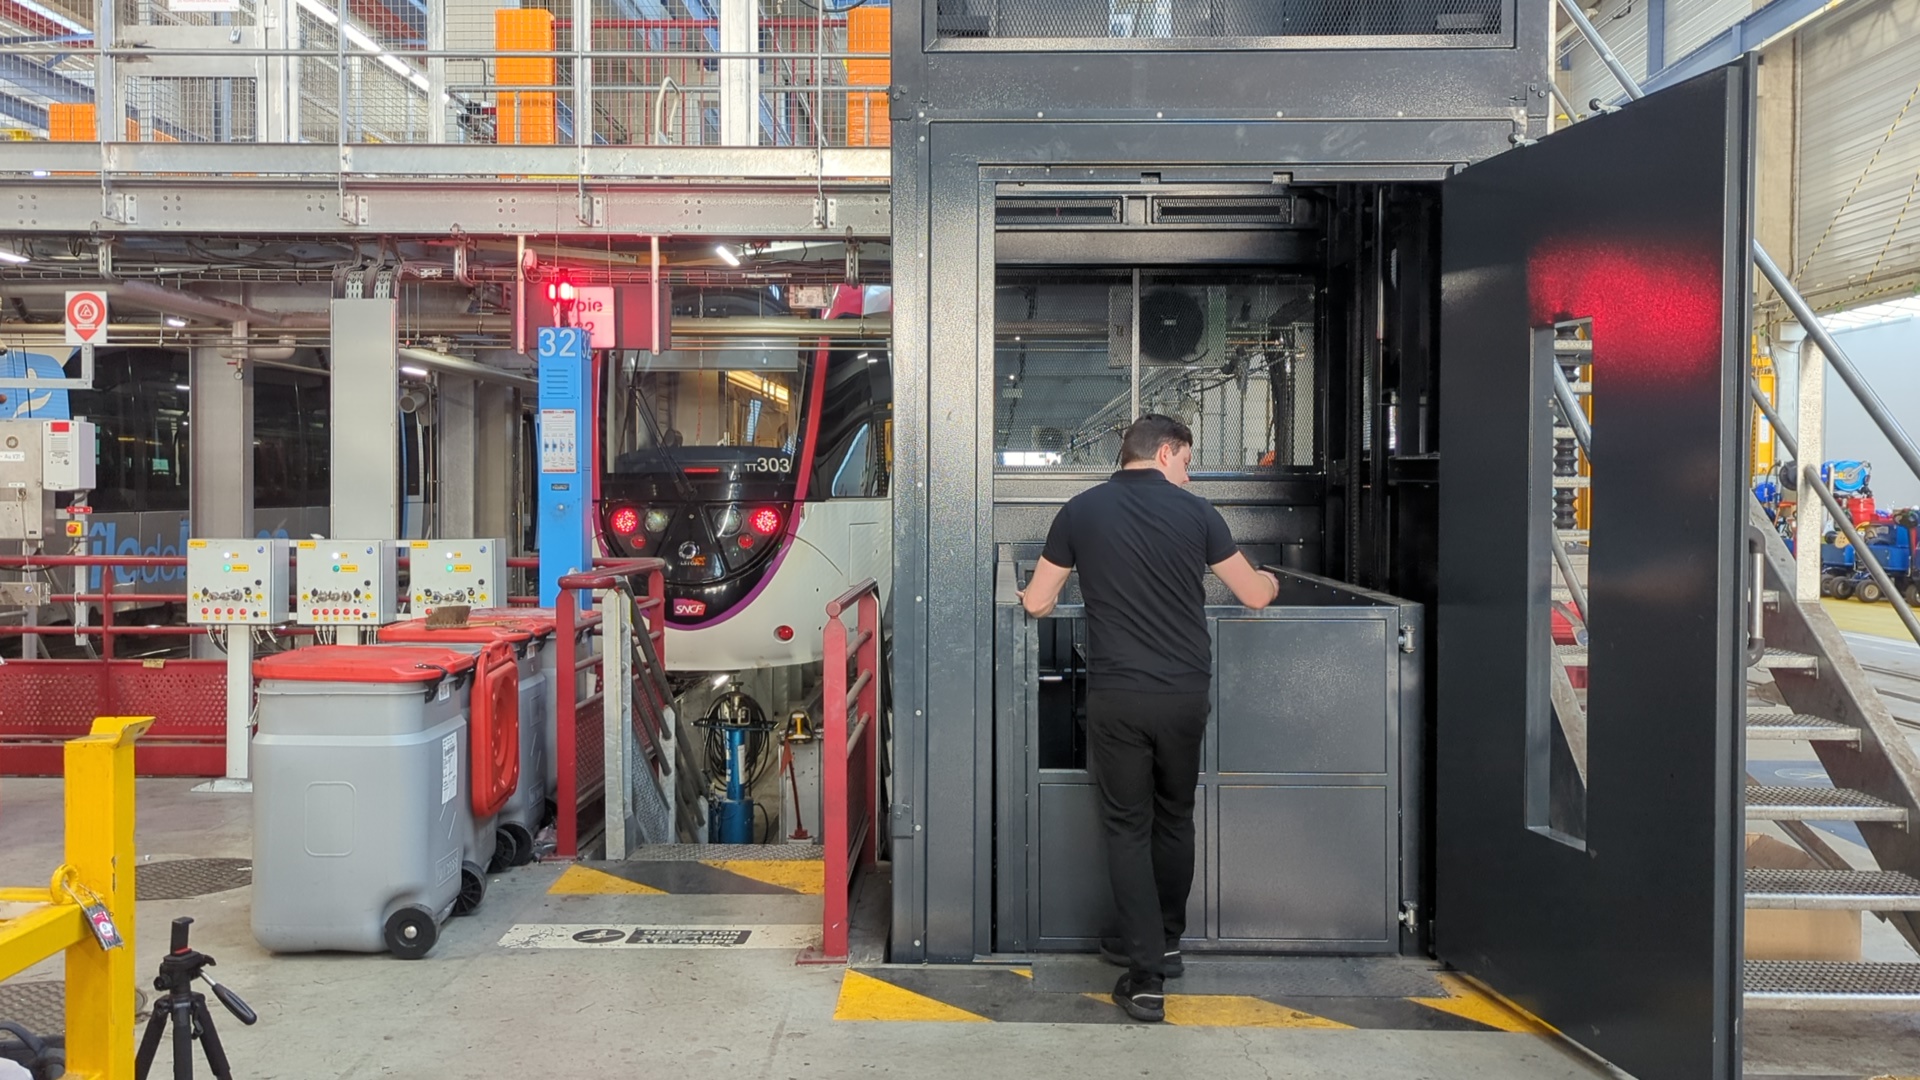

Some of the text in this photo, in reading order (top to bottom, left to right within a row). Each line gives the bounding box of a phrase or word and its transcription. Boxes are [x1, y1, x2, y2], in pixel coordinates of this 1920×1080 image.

[539, 328, 576, 358] 32
[745, 457, 790, 473] TT303
[675, 604, 704, 614] SNCF
